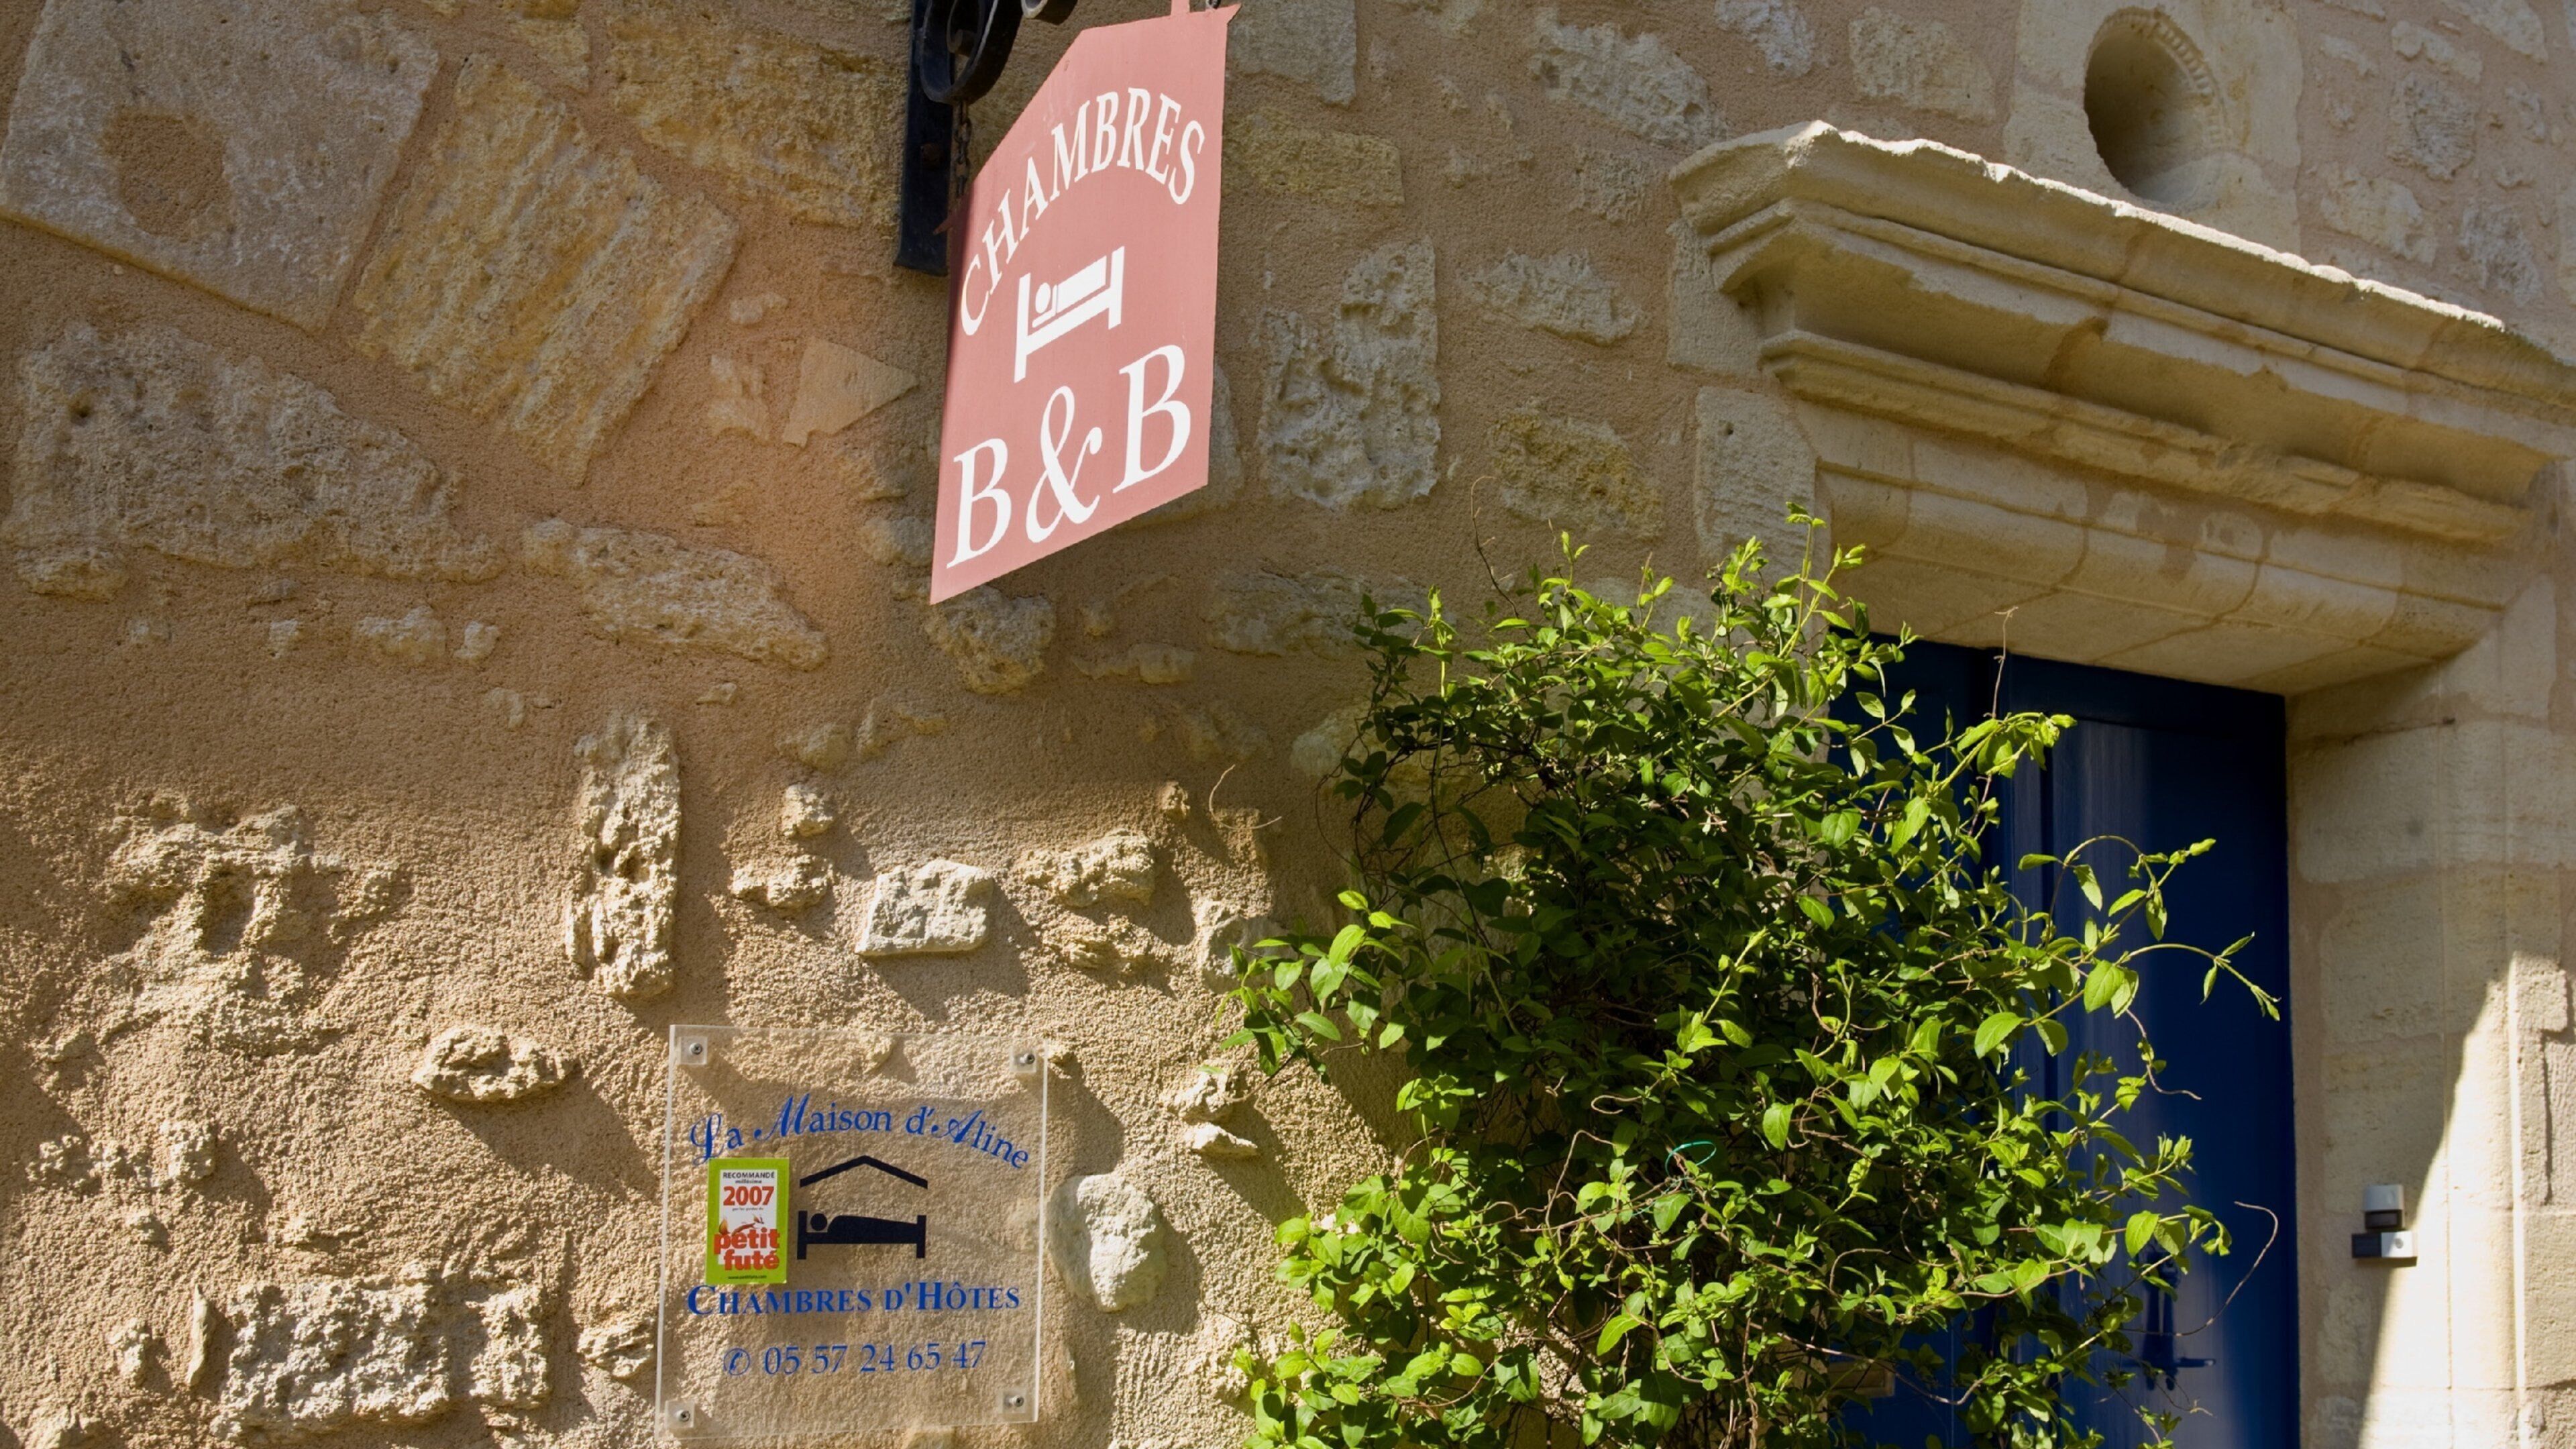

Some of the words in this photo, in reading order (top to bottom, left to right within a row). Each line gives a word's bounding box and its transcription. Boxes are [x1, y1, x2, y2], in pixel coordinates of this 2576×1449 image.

[960, 87, 1205, 336] CHAMBRES
[946, 344, 1191, 569] B&B
[690, 1114, 745, 1165] La
[754, 1093, 892, 1140] Maison
[906, 1106, 1029, 1169] d'Aline
[723, 1186, 774, 1205] 2007
[714, 1227, 780, 1255] petit
[724, 1249, 780, 1271] futé
[687, 1284, 872, 1315] CHAMBRES
[885, 1282, 1020, 1310] D'HÔTES
[764, 1346, 800, 1375] 05
[812, 1345, 848, 1373] 57
[860, 1344, 895, 1372] 24
[908, 1343, 941, 1370] 65
[953, 1341, 986, 1368] 47
